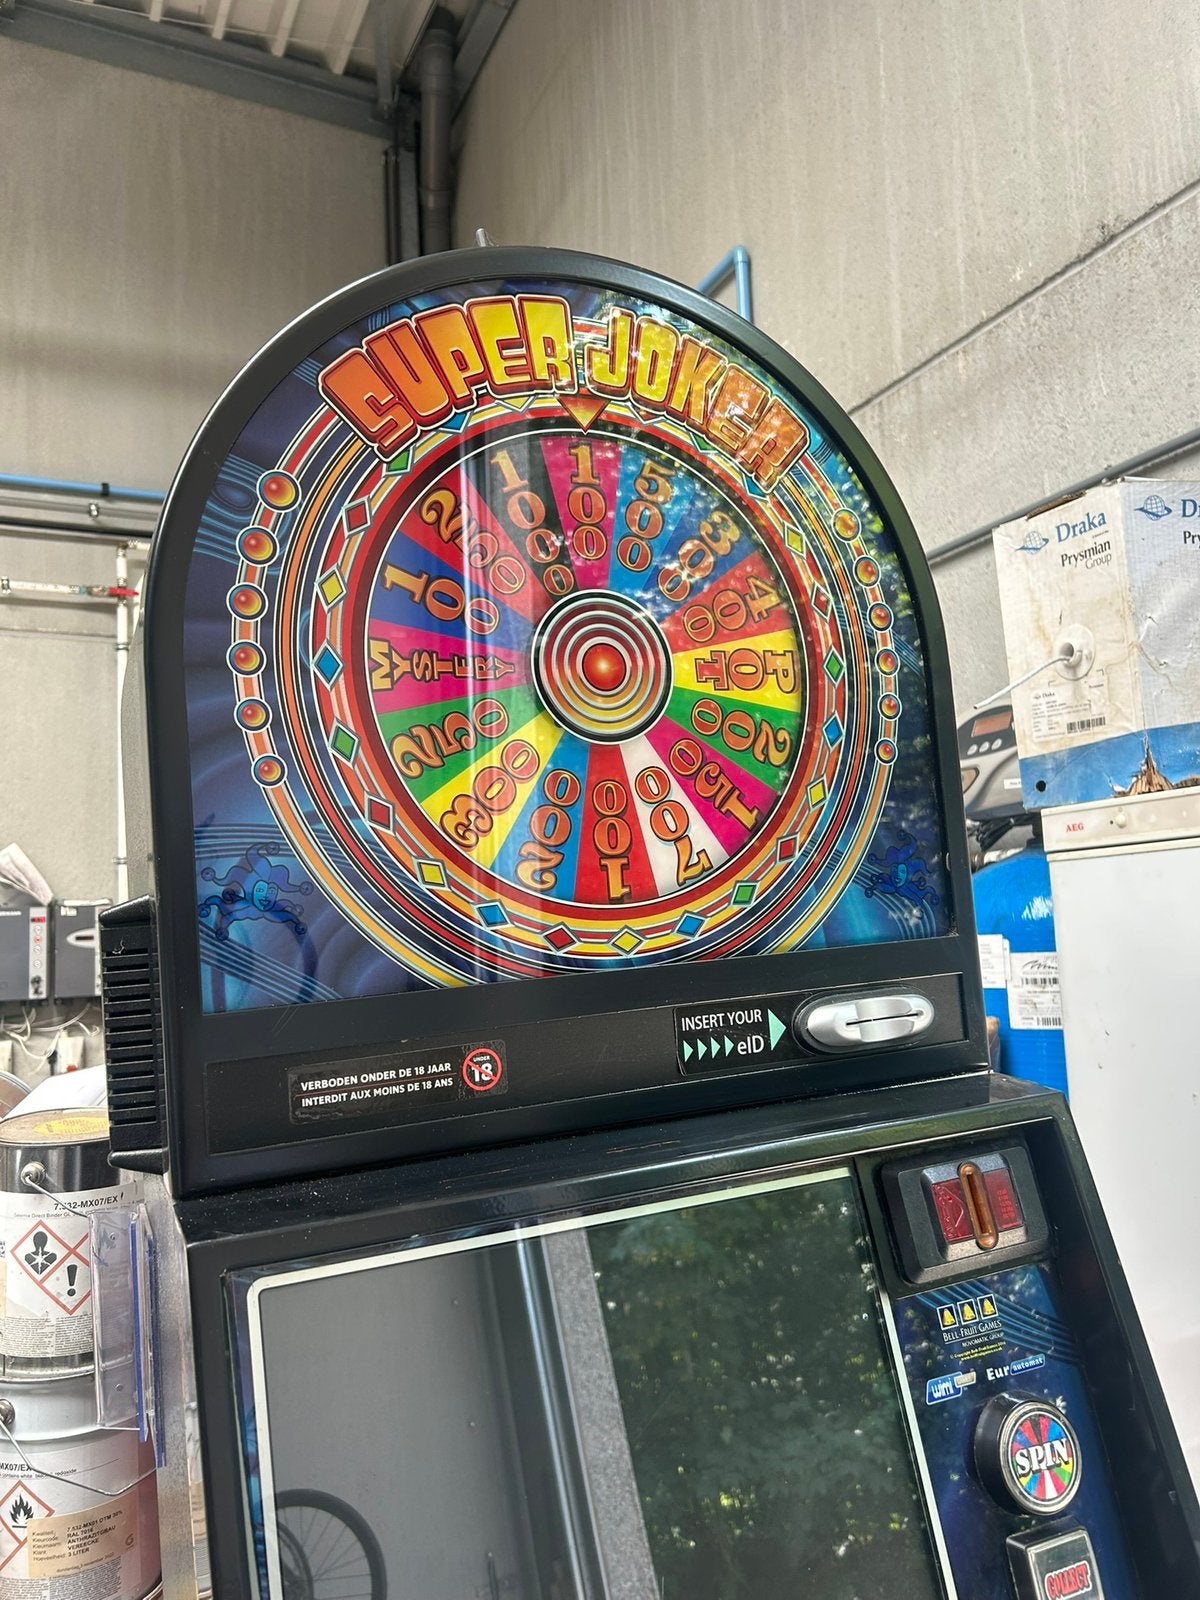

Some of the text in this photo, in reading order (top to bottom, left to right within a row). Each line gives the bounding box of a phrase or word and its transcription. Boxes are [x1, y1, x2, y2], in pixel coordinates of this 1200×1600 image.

[318, 294, 811, 494] SUPER JOKER
[490, 448, 575, 597] 1000
[568, 442, 607, 561] 100
[617, 458, 678, 574] 500
[419, 486, 527, 596] 250
[1055, 511, 1107, 543] Draka
[658, 510, 740, 602] 300
[1061, 540, 1111, 567] Prysmian
[1085, 552, 1112, 570] Group
[382, 563, 500, 636] 100
[682, 575, 783, 643] 400
[368, 636, 515, 693] MYSTERY
[694, 647, 797, 694] POT
[389, 697, 510, 780] 250
[690, 697, 792, 768] 200
[438, 739, 540, 851] 300
[670, 736, 760, 832] 150
[514, 769, 581, 892] 200
[592, 779, 632, 902] 100
[634, 765, 714, 885] 700
[1066, 823, 1084, 833] AEG
[681, 1009, 763, 1031] INSERT YOUR
[473, 1054, 490, 1062] UNDER
[737, 1035, 765, 1055] eID
[301, 1062, 452, 1092] VERBODEN ONDER DE 18 JAAR
[301, 1076, 454, 1107] INTERDIT AUX MOINS DE 18 ANS
[471, 1062, 493, 1083] 18
[943, 1319, 1002, 1342] BELL-FRUIT GAMES
[989, 1332, 1005, 1340] GROUP
[1012, 1356, 1043, 1372] automat
[1015, 1437, 1070, 1478] SPIN
[72, 1546, 90, 1556] LITER
[1046, 1562, 1091, 1600] COLLECT
